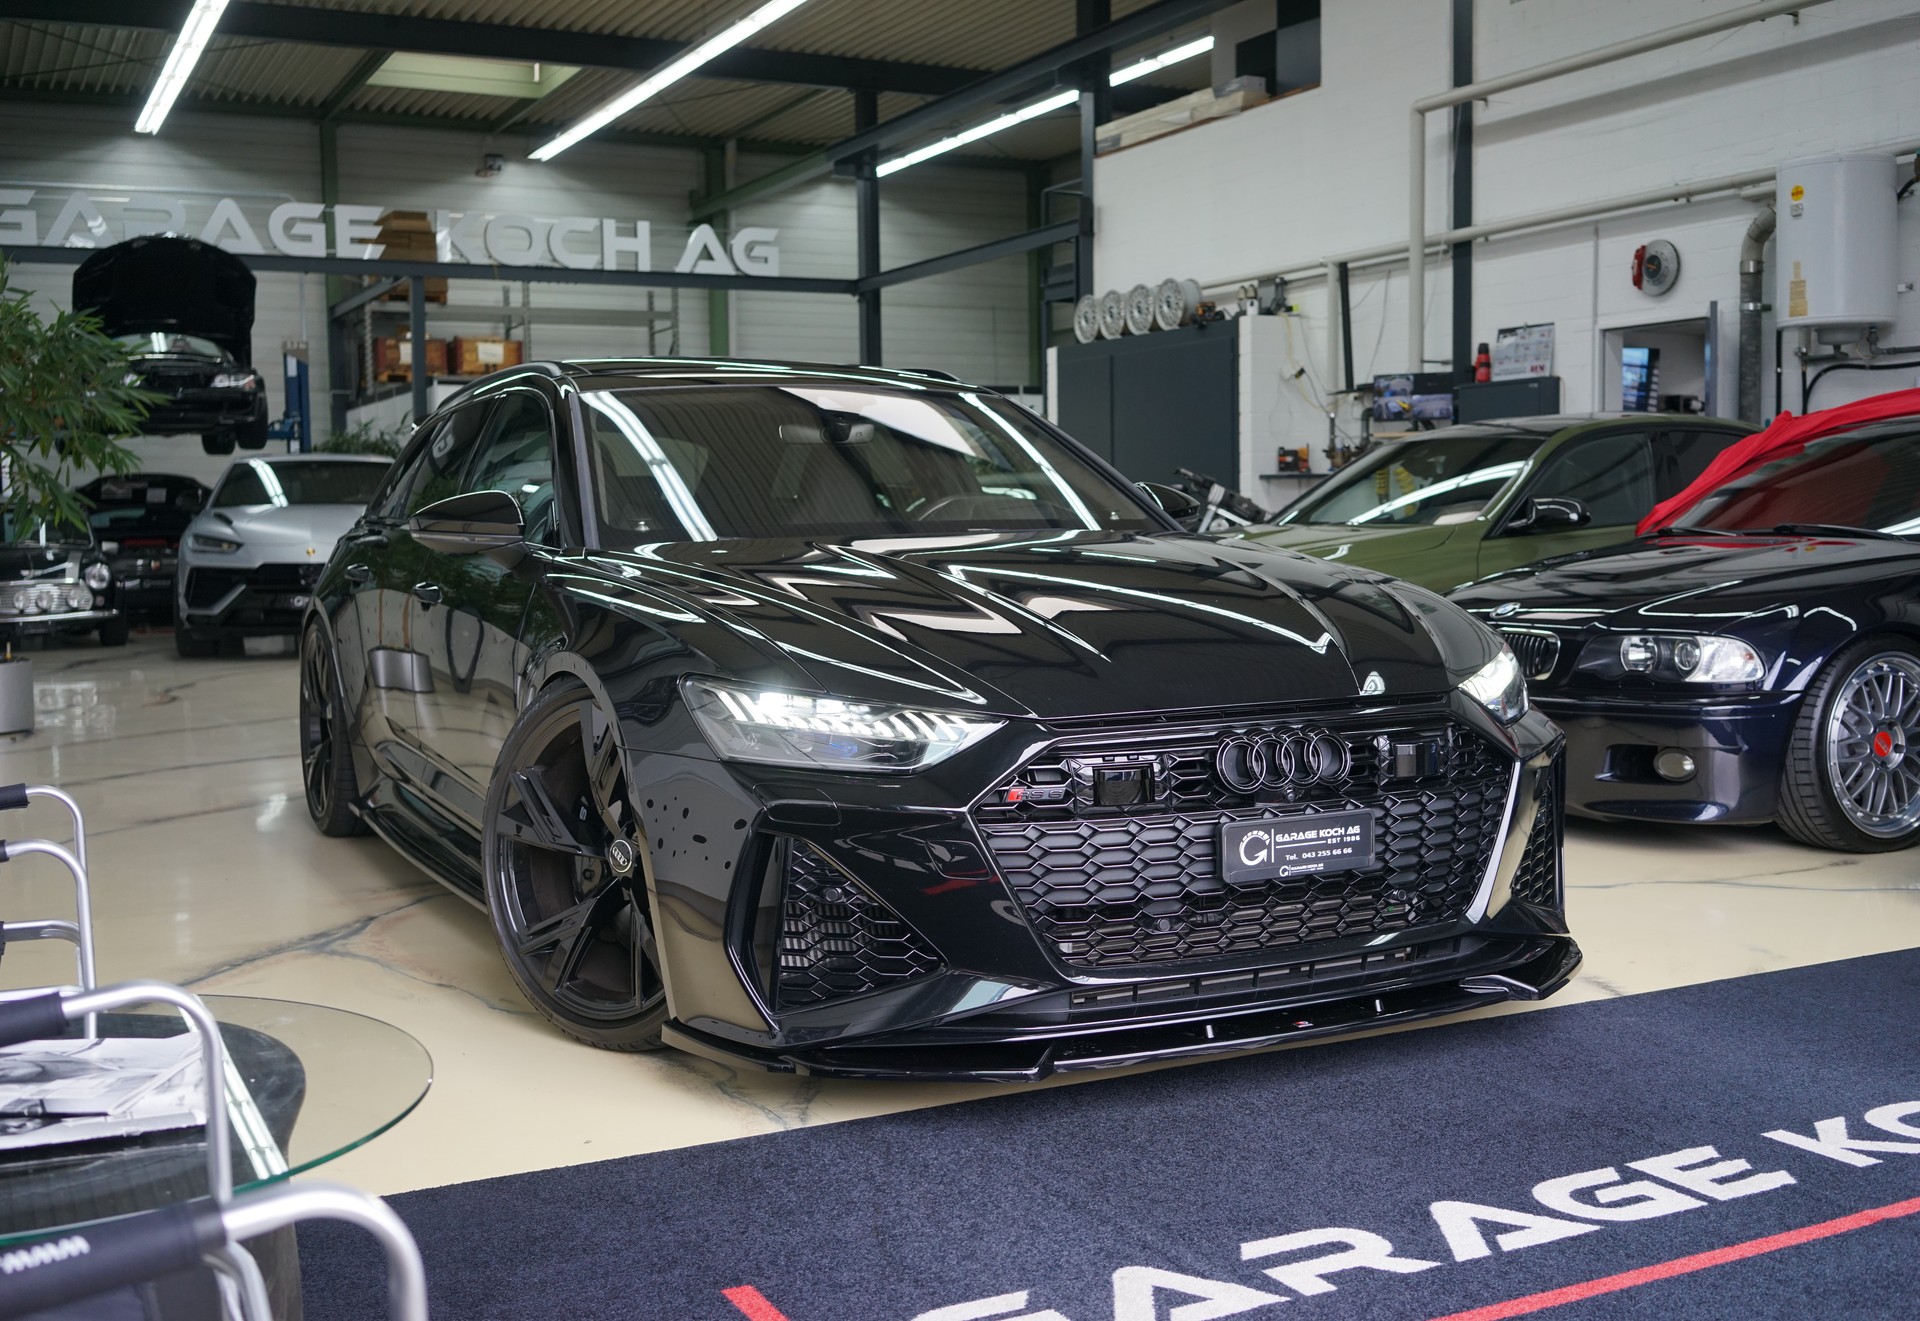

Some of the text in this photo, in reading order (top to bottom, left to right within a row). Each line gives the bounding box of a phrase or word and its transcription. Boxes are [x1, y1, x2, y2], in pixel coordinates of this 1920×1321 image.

[0, 189, 780, 277] GARAGE KOCH AG
[1275, 825, 1361, 842] GARAGE KOCH AG
[1302, 851, 1316, 859] 043
[1317, 849, 1331, 857] 255
